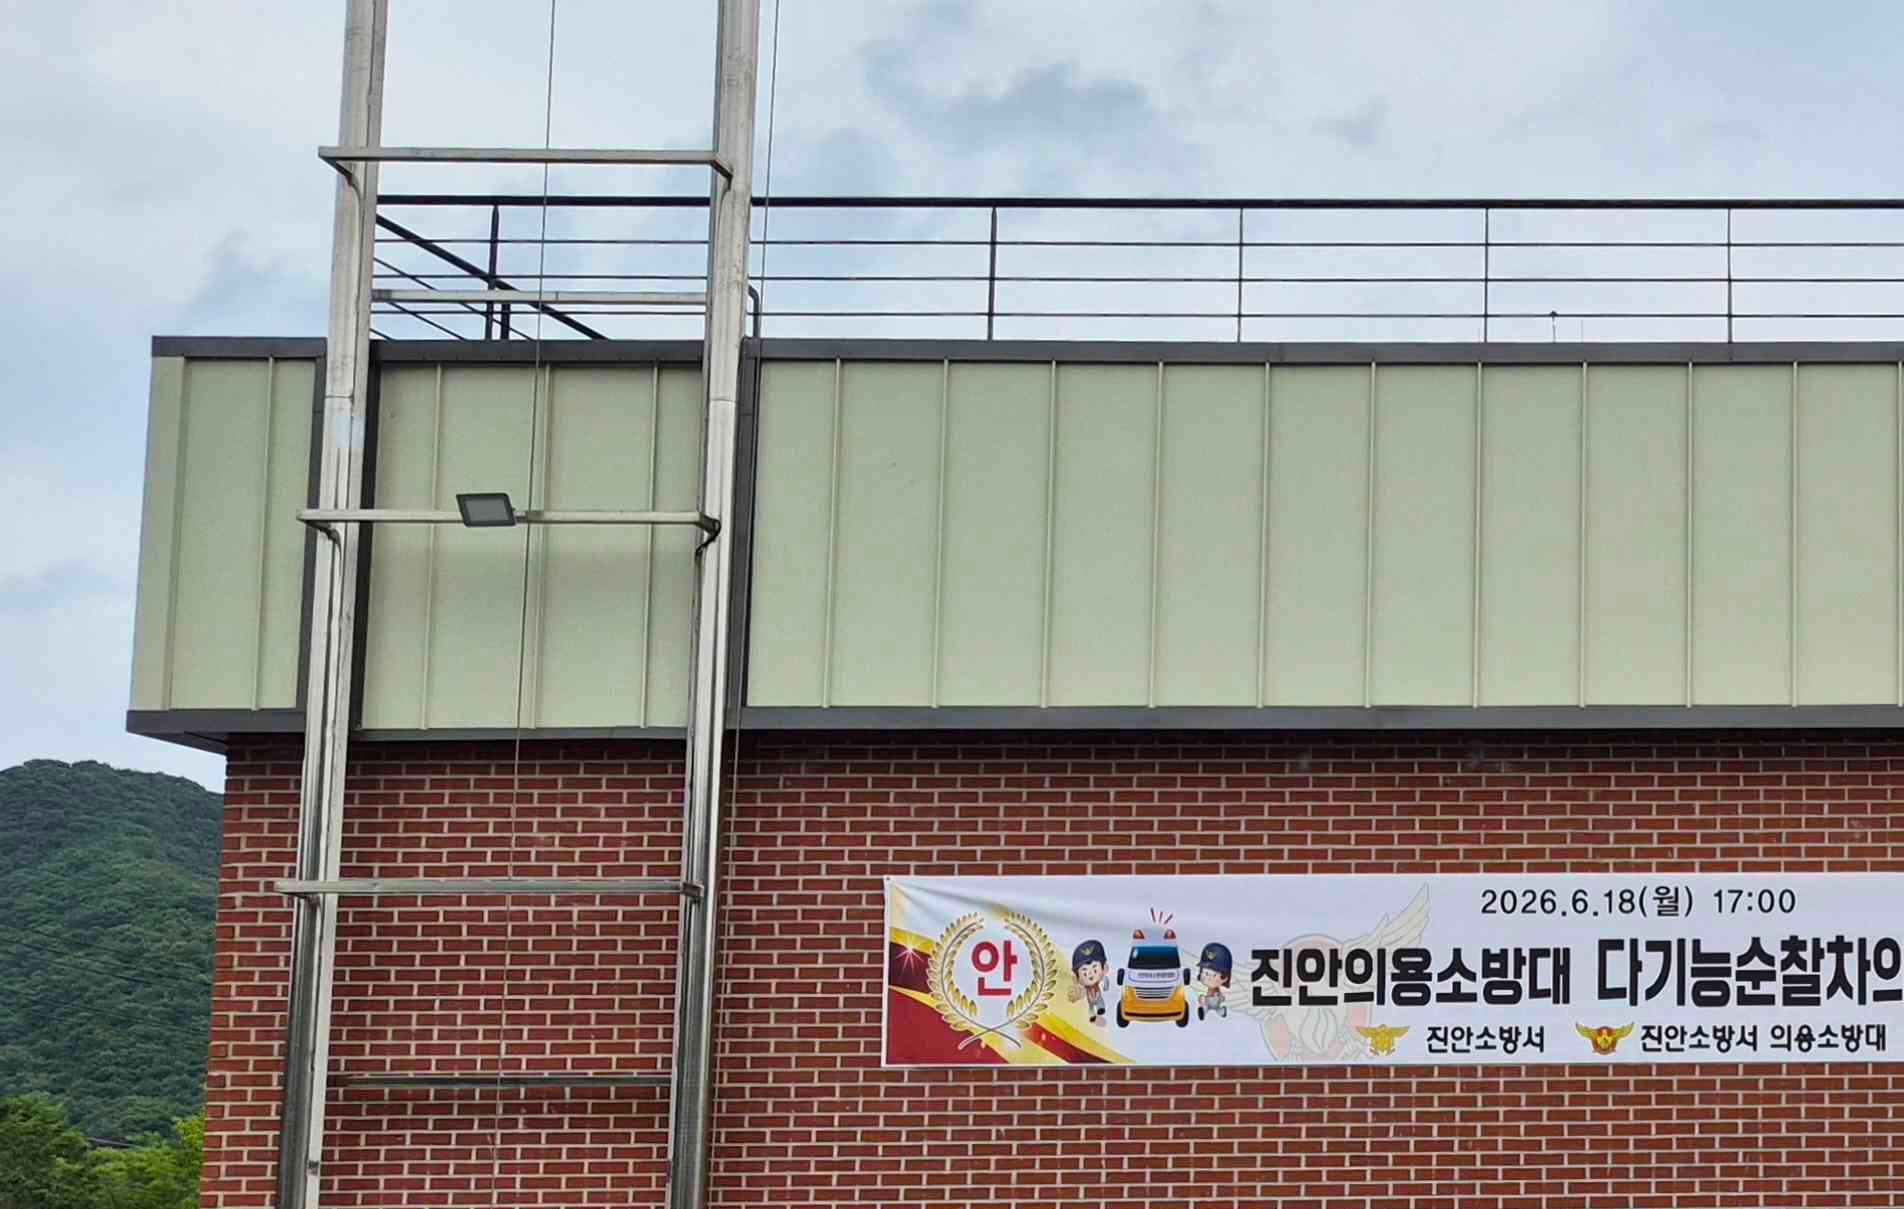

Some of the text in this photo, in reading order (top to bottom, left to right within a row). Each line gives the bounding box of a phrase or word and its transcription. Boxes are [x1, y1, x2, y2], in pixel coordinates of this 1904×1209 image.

[1481, 884, 1796, 917] 2026.6.18(월) 17:00
[972, 940, 1018, 996] 안
[1250, 946, 1571, 1007] 진안의용소방대
[1426, 1024, 1545, 1054] 진안소방서
[1639, 1022, 1887, 1053] 진안소방서 의용소방대
